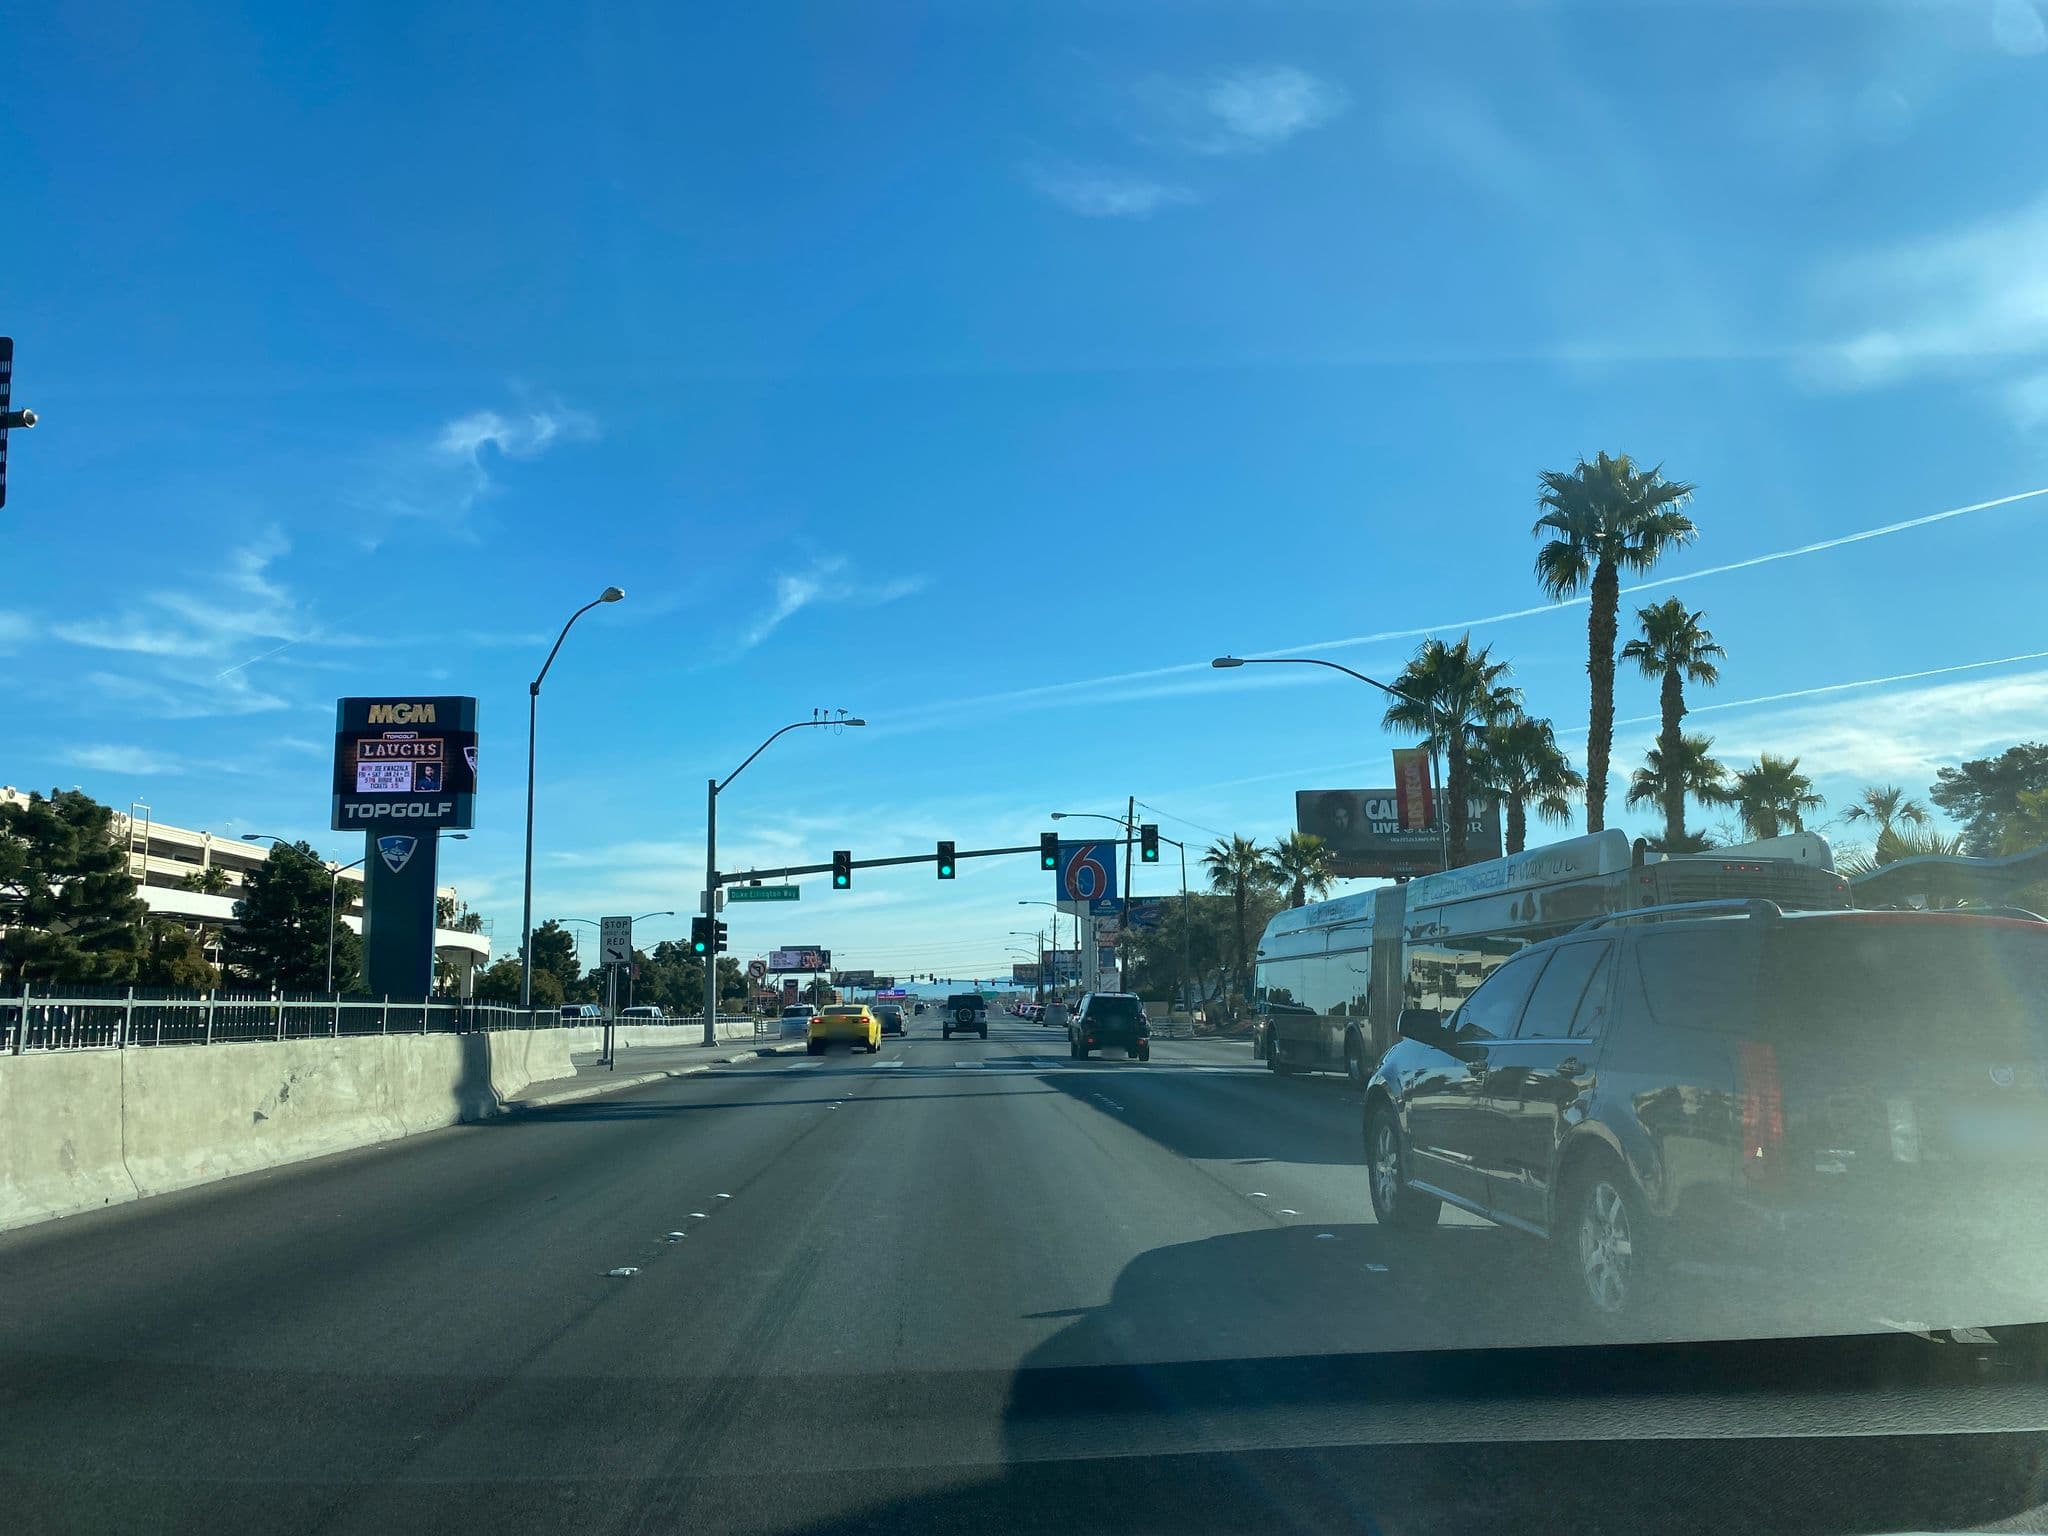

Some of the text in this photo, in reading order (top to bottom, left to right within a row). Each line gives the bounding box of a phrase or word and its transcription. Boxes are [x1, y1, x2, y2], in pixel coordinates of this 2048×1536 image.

[367, 703, 436, 724] MGM
[364, 744, 437, 757] LAUGHS
[344, 803, 453, 819] TOPGOLF
[1372, 822, 1400, 834] LIVE
[1065, 844, 1107, 901] 6
[784, 889, 796, 898] Way
[604, 920, 628, 929] STOP
[606, 937, 625, 945] RED
